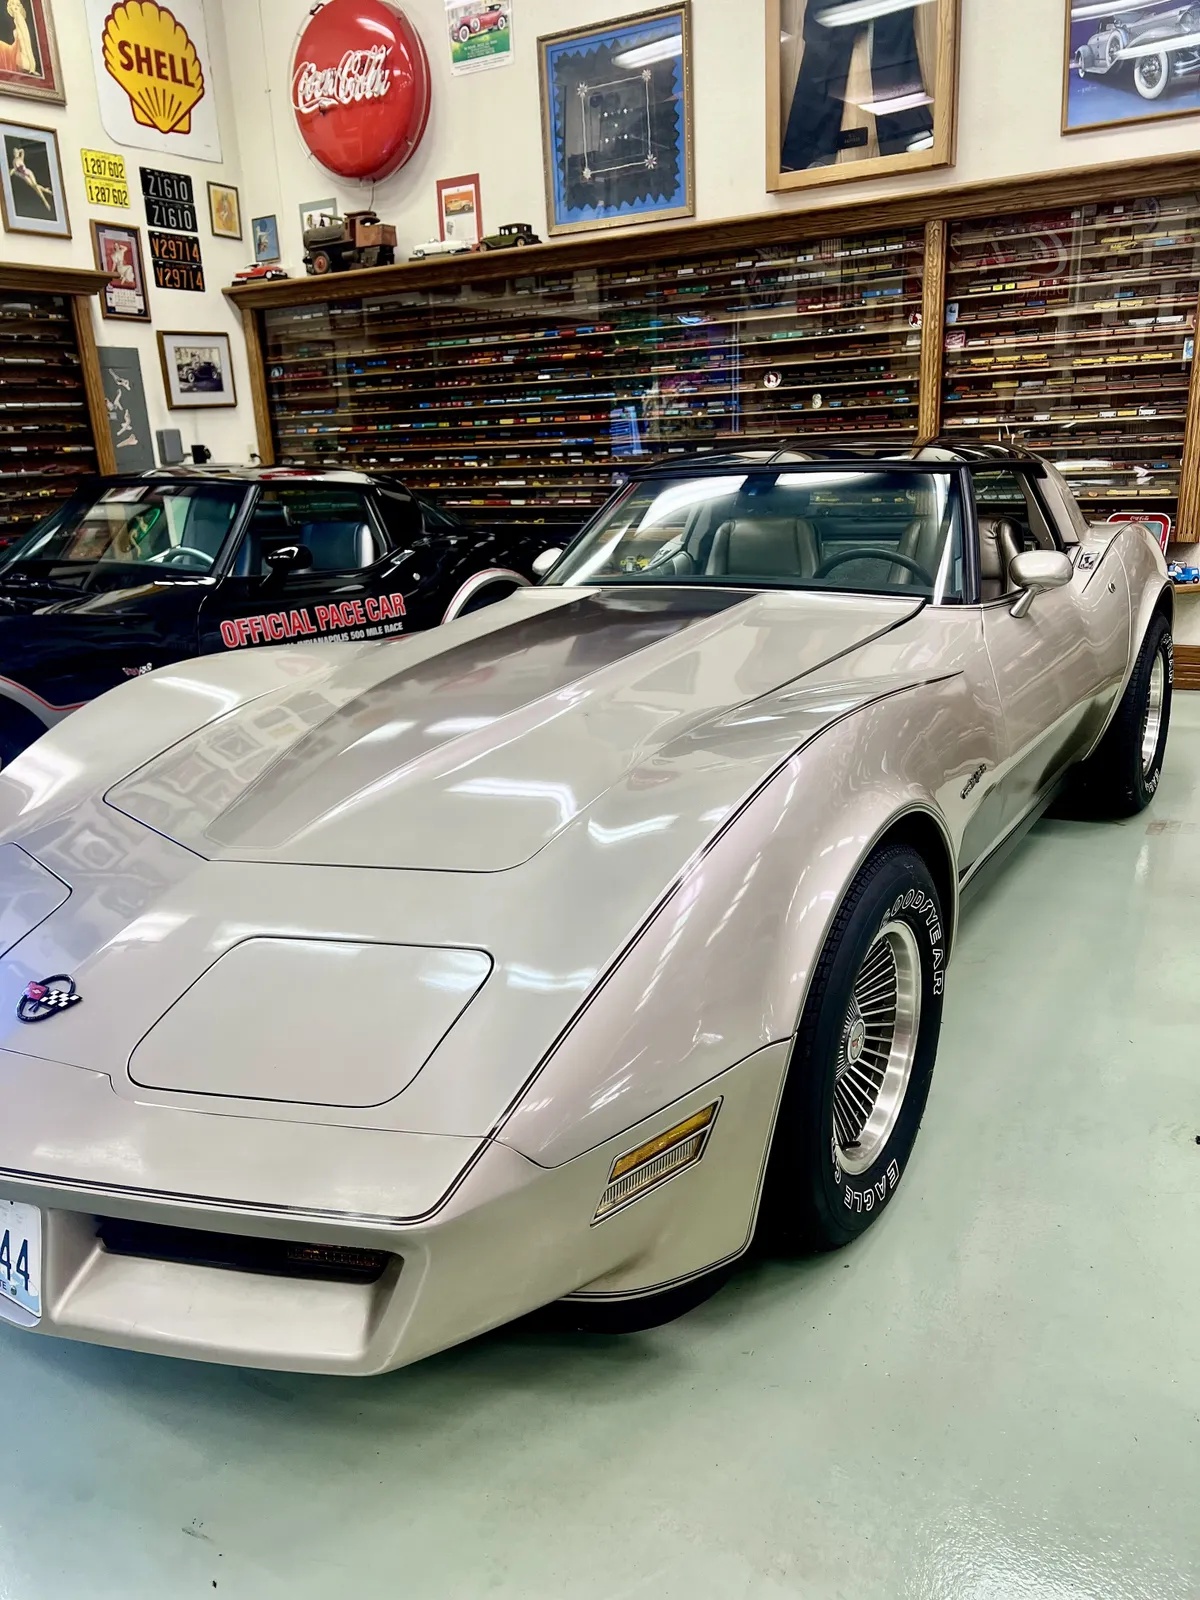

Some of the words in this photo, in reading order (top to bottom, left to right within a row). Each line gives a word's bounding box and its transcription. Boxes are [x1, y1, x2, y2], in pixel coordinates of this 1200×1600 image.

[118, 40, 195, 88] SHELL
[147, 175, 188, 201] Z1610
[152, 205, 193, 230] Z1610
[151, 237, 201, 262] V29714
[155, 267, 204, 290] V29714
[219, 608, 317, 648] OFFICIAL
[314, 600, 367, 631] PACE
[364, 592, 407, 622] CAR
[350, 629, 365, 640] 500
[365, 625, 384, 637] MILE
[383, 621, 404, 634] RACE
[879, 888, 944, 997] GOODYEAR
[843, 1158, 900, 1213] EAGLE
